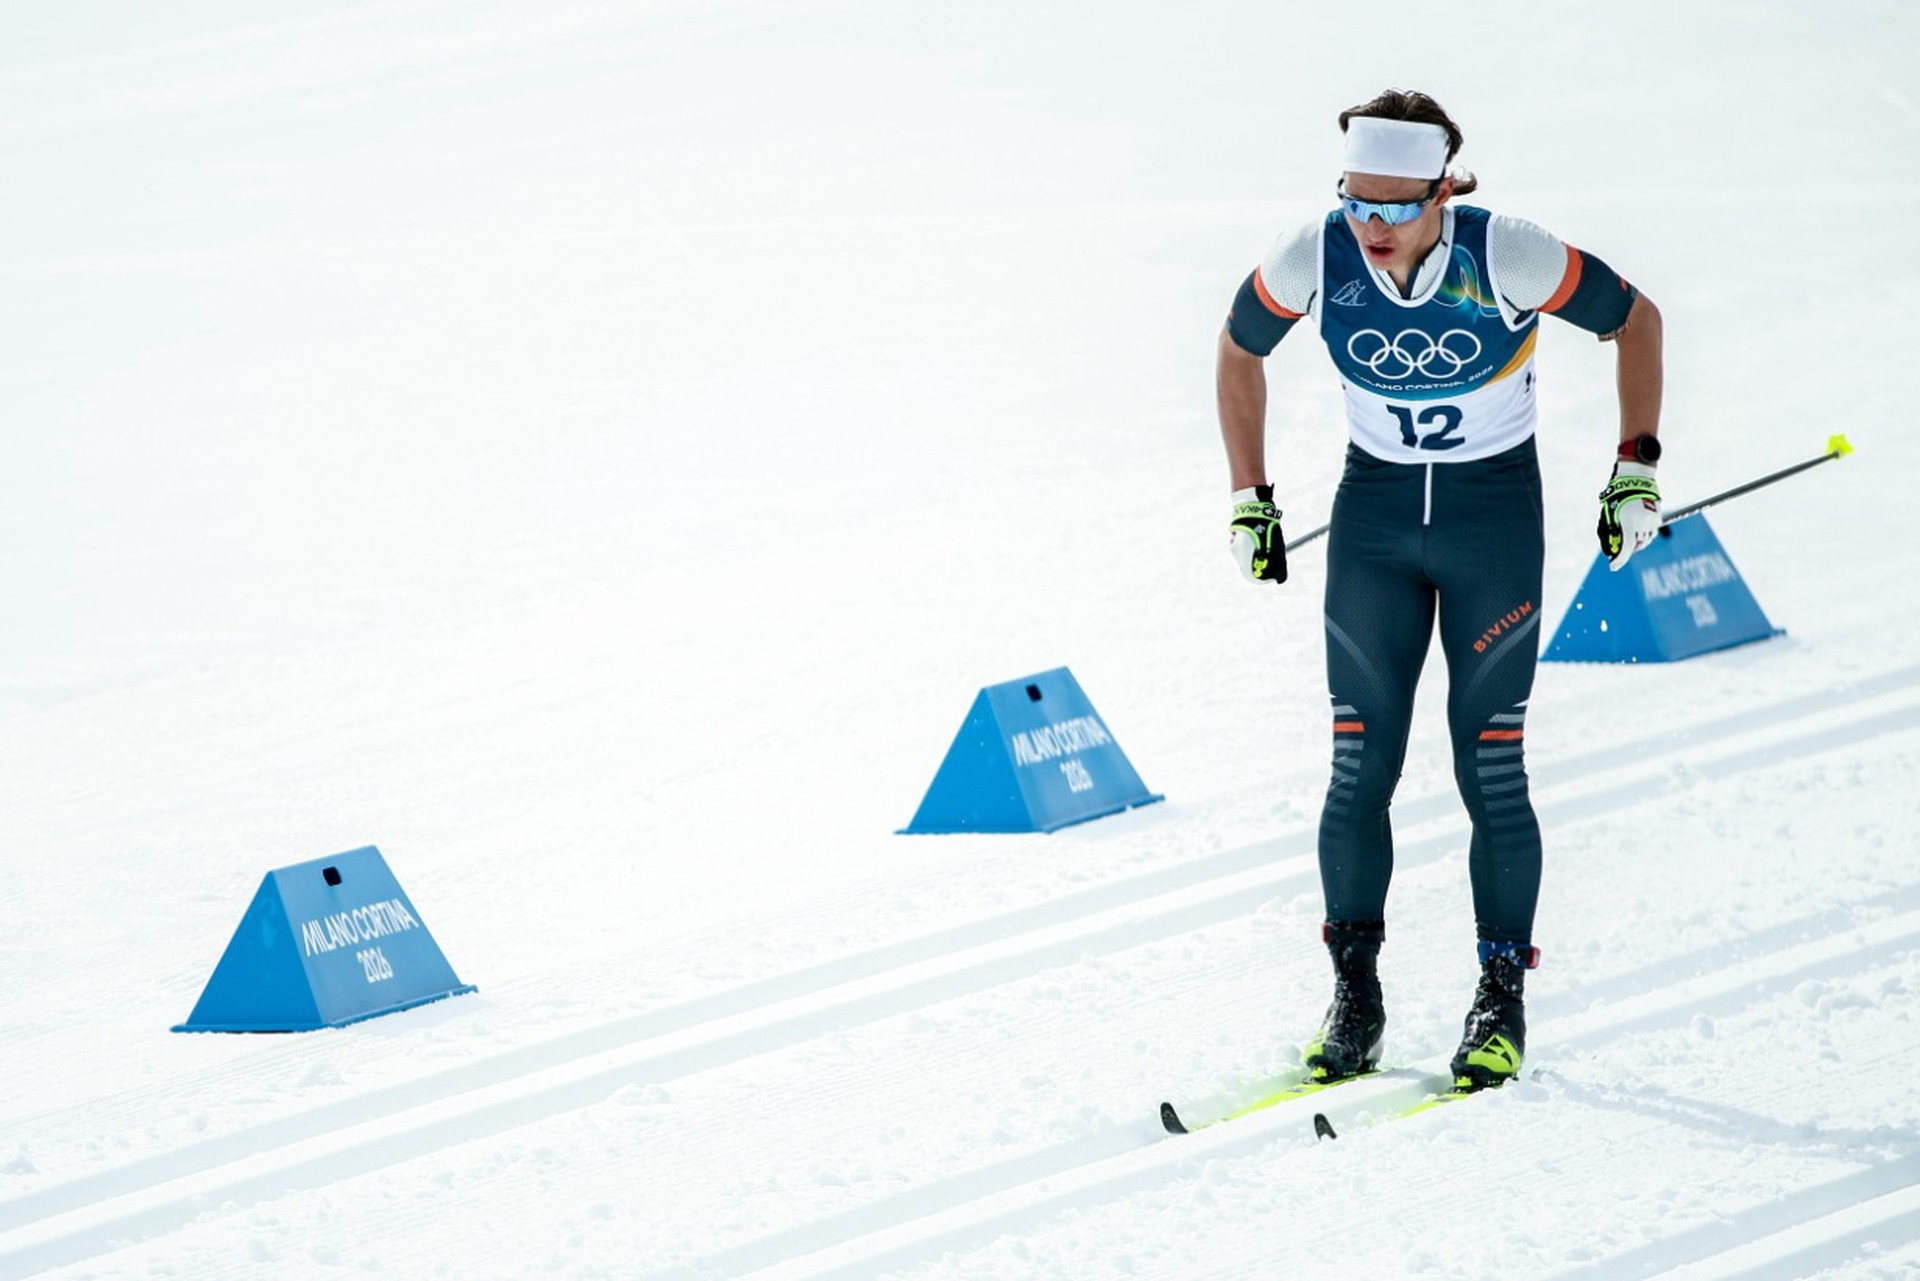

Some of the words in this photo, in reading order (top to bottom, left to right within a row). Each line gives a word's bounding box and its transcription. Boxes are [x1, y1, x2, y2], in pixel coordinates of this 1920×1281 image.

[1386, 403, 1465, 449] 12
[1473, 601, 1532, 653] BIVIUM
[1012, 727, 1061, 767] MILANO
[1054, 716, 1111, 754] CORTINA
[302, 912, 359, 957] MILANO
[352, 899, 419, 940] CORTINA
[356, 947, 393, 983] 2026
